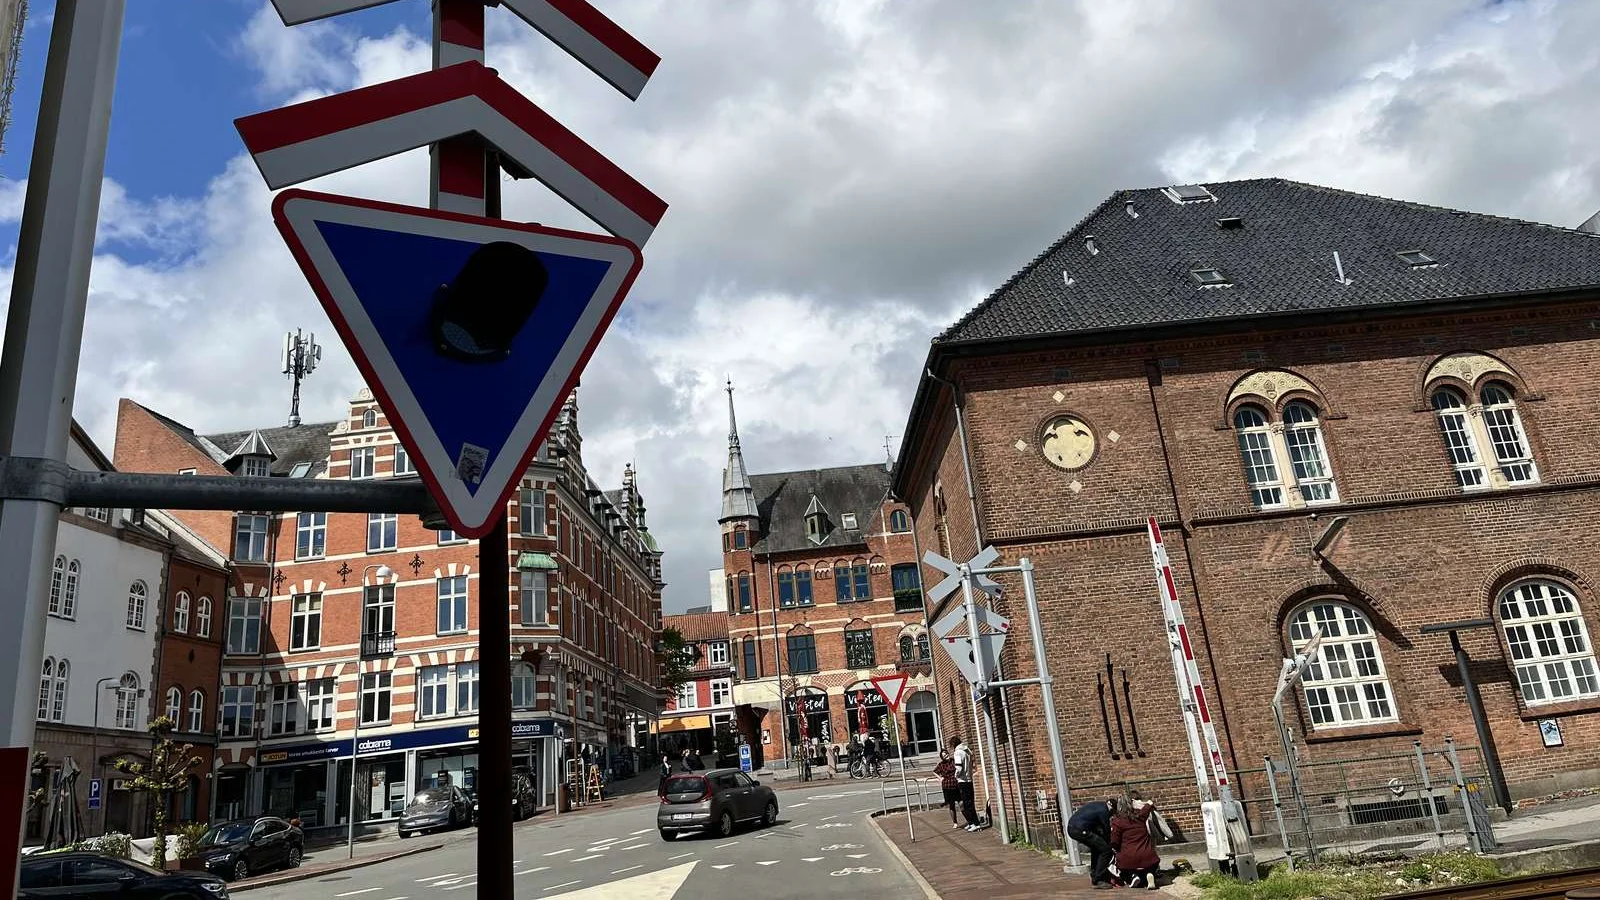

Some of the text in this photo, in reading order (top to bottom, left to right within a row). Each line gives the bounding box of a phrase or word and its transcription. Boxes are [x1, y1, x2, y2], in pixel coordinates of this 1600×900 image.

[512, 723, 540, 732] colorama
[358, 739, 391, 750] colorama
[91, 781, 99, 796] P
